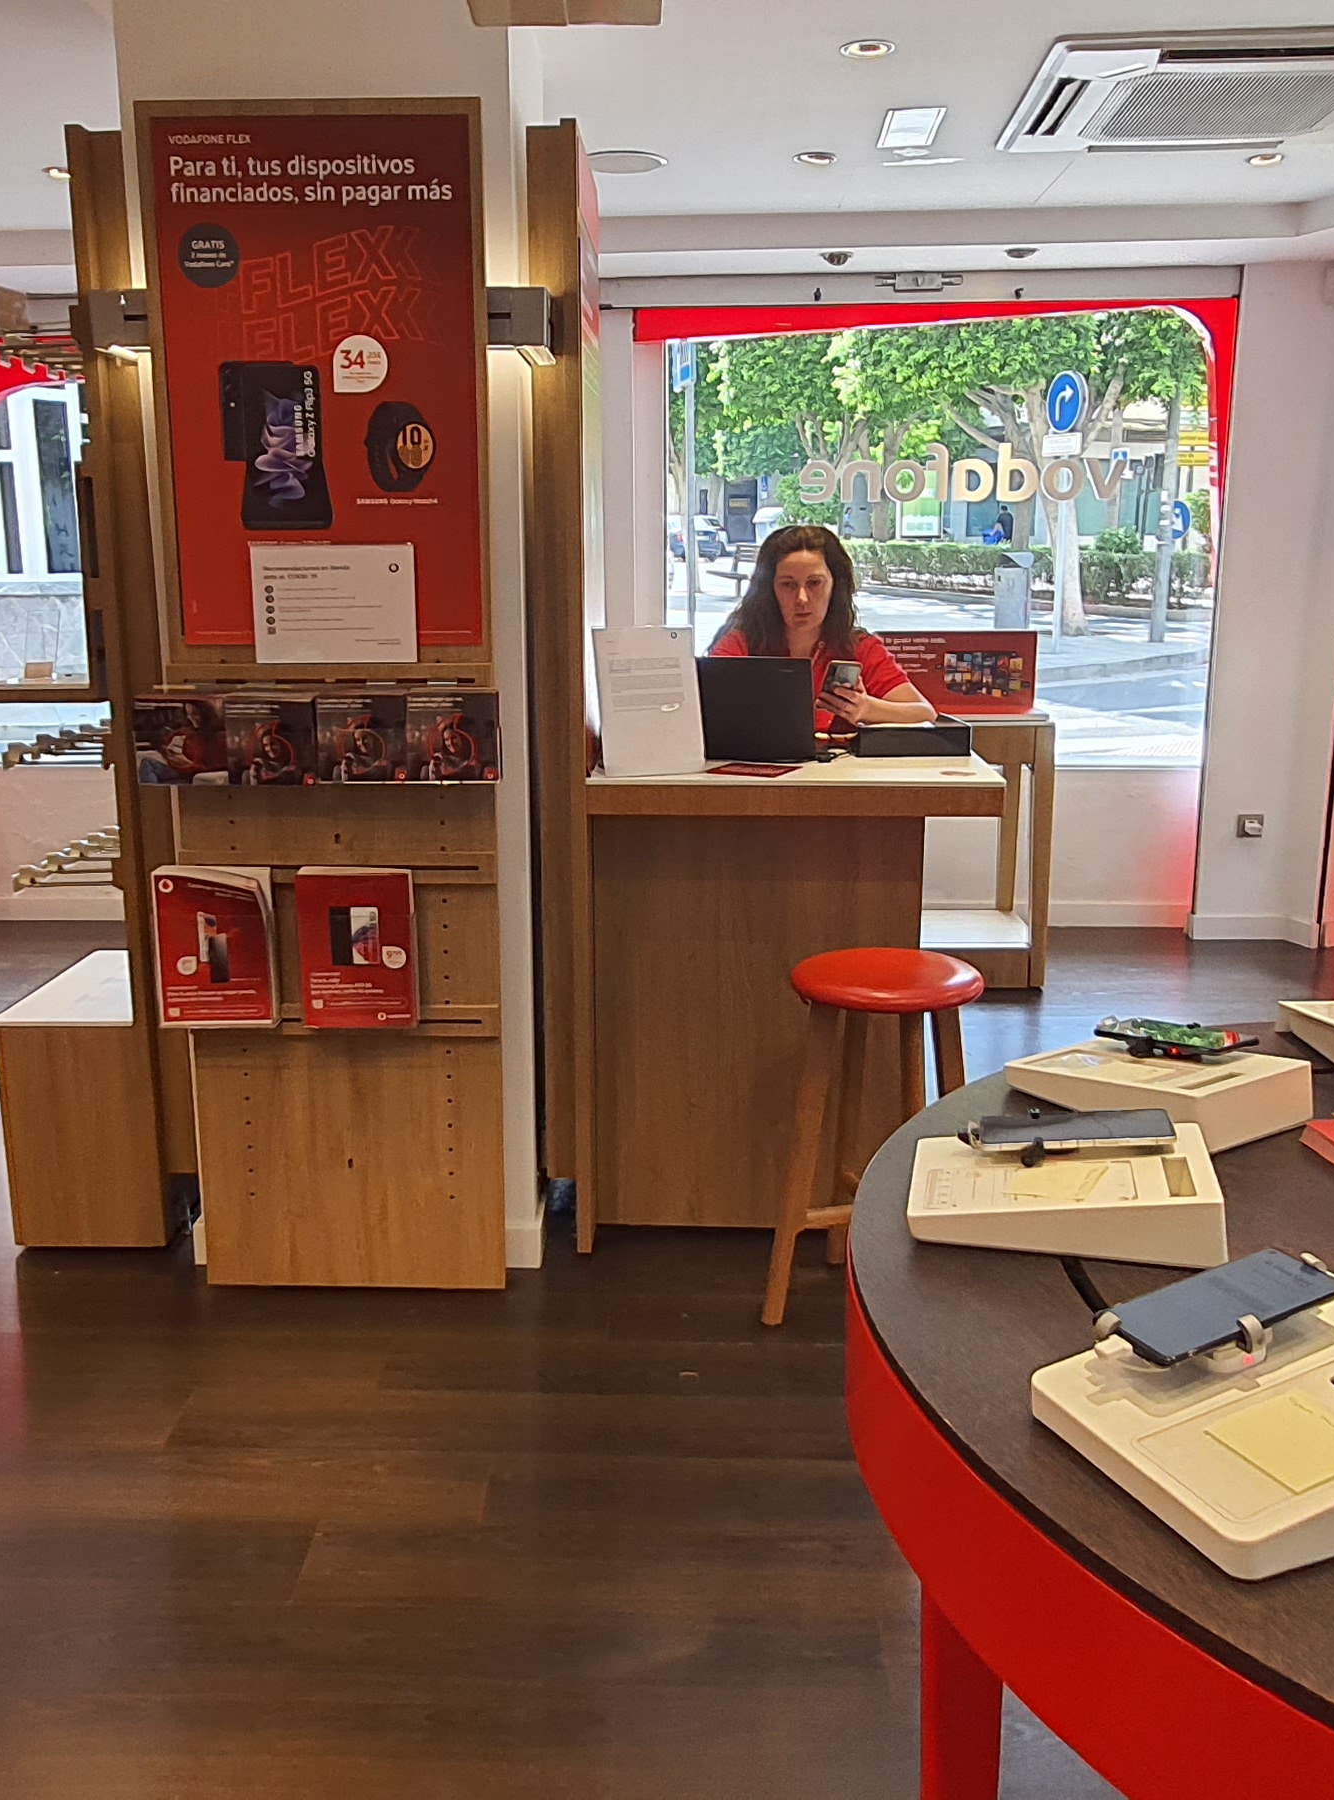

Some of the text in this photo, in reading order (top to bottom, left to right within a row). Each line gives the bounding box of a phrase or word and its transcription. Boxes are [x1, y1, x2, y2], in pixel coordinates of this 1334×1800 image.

[168, 134, 251, 145] VODAFONE FLEX
[169, 153, 415, 180] Para ti, tus dispositivos
[170, 178, 452, 206] financiados, sin pagar más
[191, 240, 225, 250] GRATIS
[239, 225, 397, 315] FLEX
[242, 286, 400, 365] FLEX
[339, 349, 366, 370] 34
[303, 370, 316, 458] Galaxy Z Flip3 5G
[293, 404, 304, 458] SAMSUNG
